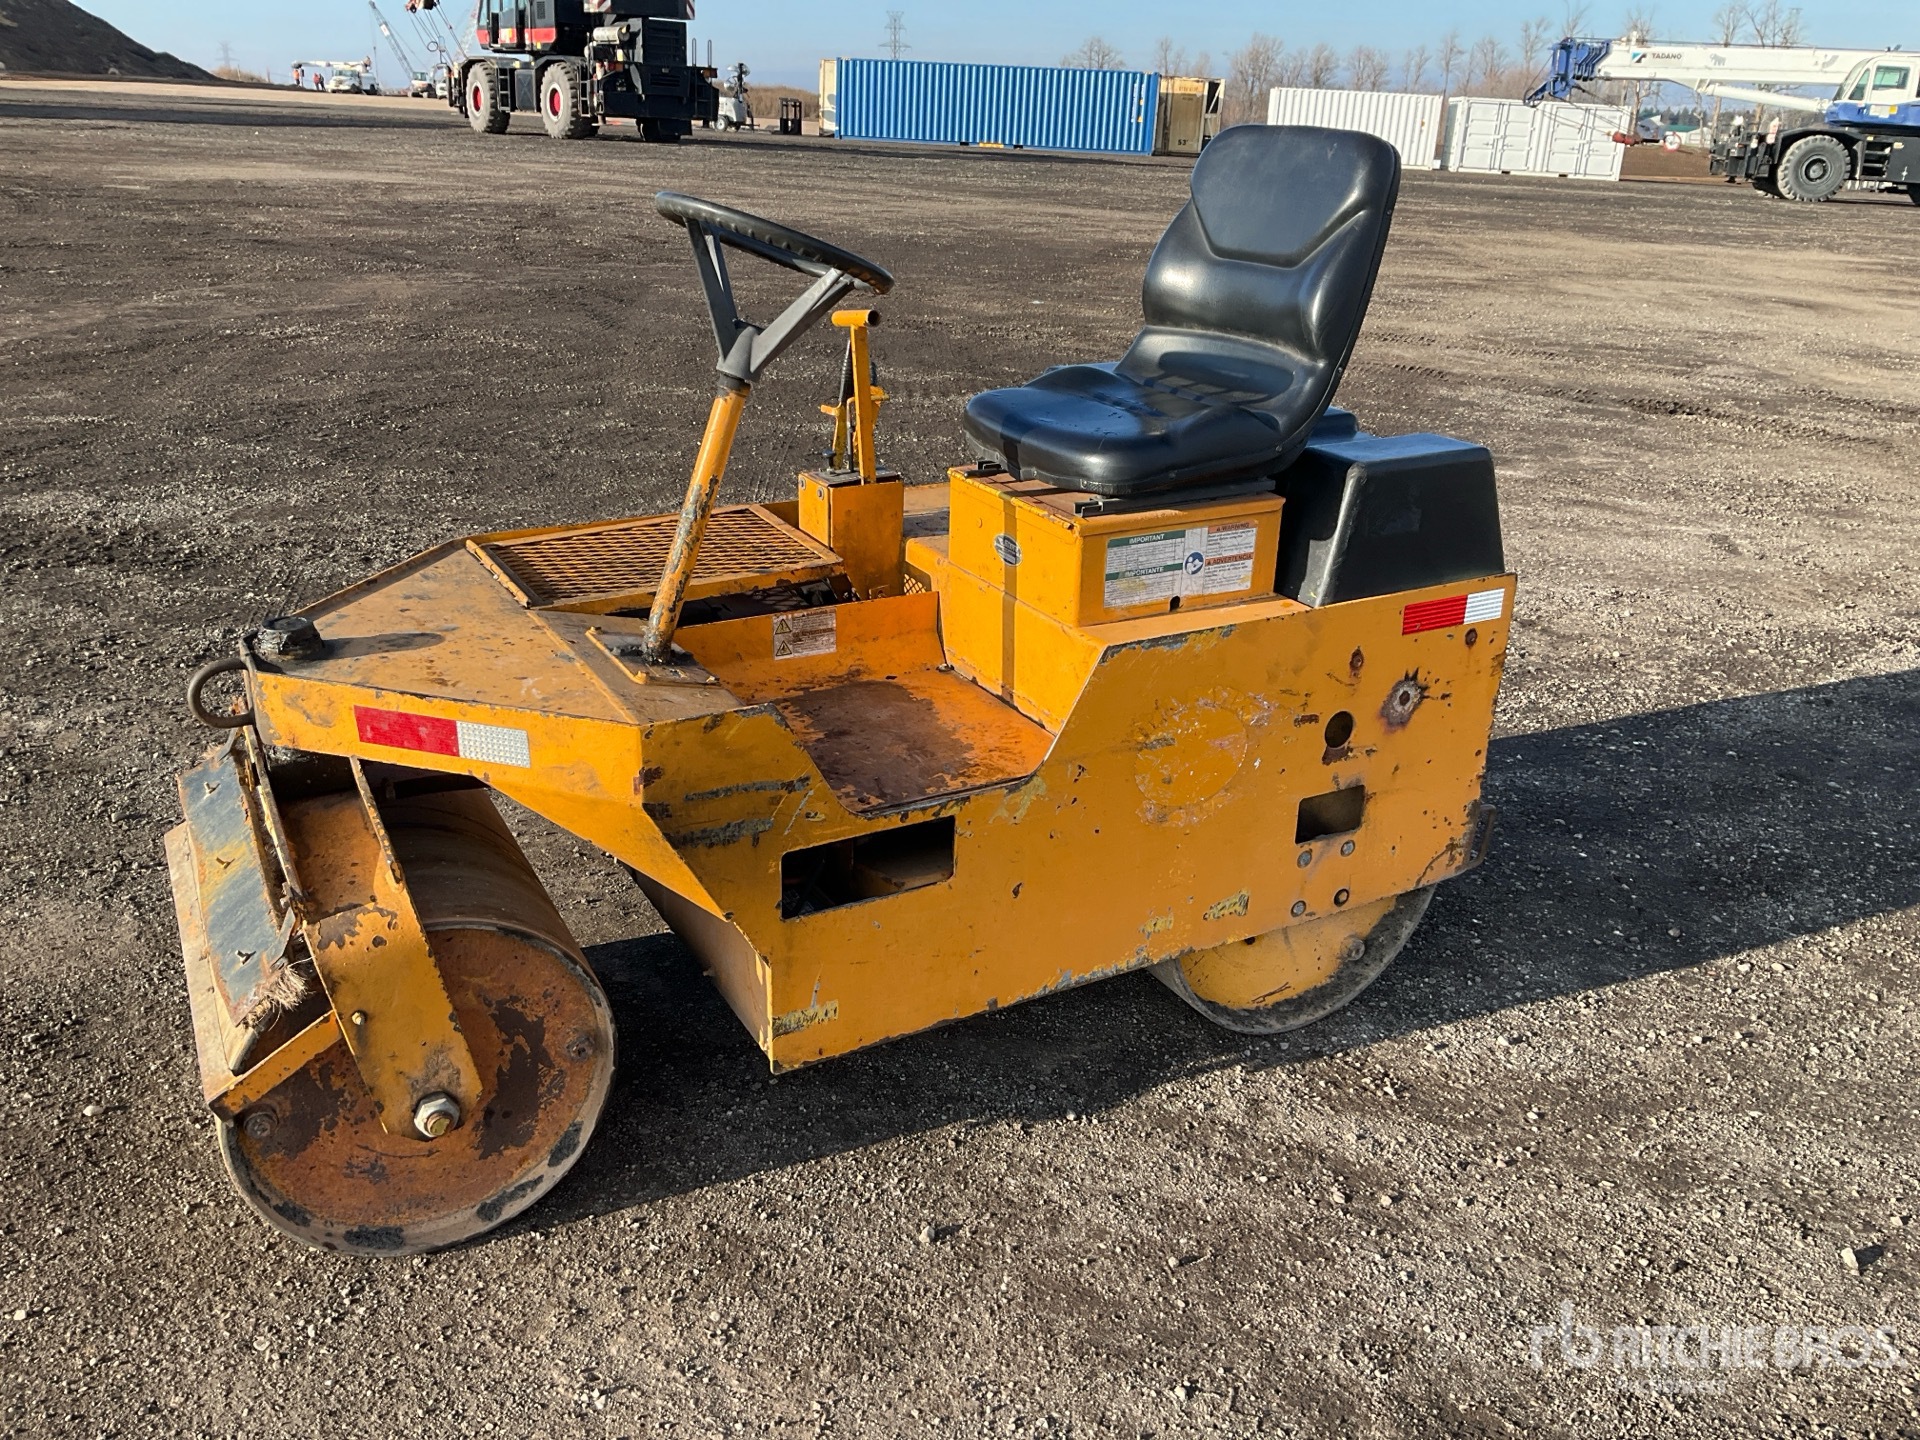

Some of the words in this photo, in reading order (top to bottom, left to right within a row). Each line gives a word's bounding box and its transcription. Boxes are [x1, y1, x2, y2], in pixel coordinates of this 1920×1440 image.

[1651, 52, 1682, 60] TADANO
[1222, 522, 1250, 531] WARNING
[1129, 533, 1165, 544] IMPORTANT
[1212, 554, 1253, 564] ADVERTENCIA
[1124, 567, 1164, 577] IMPORTANTE
